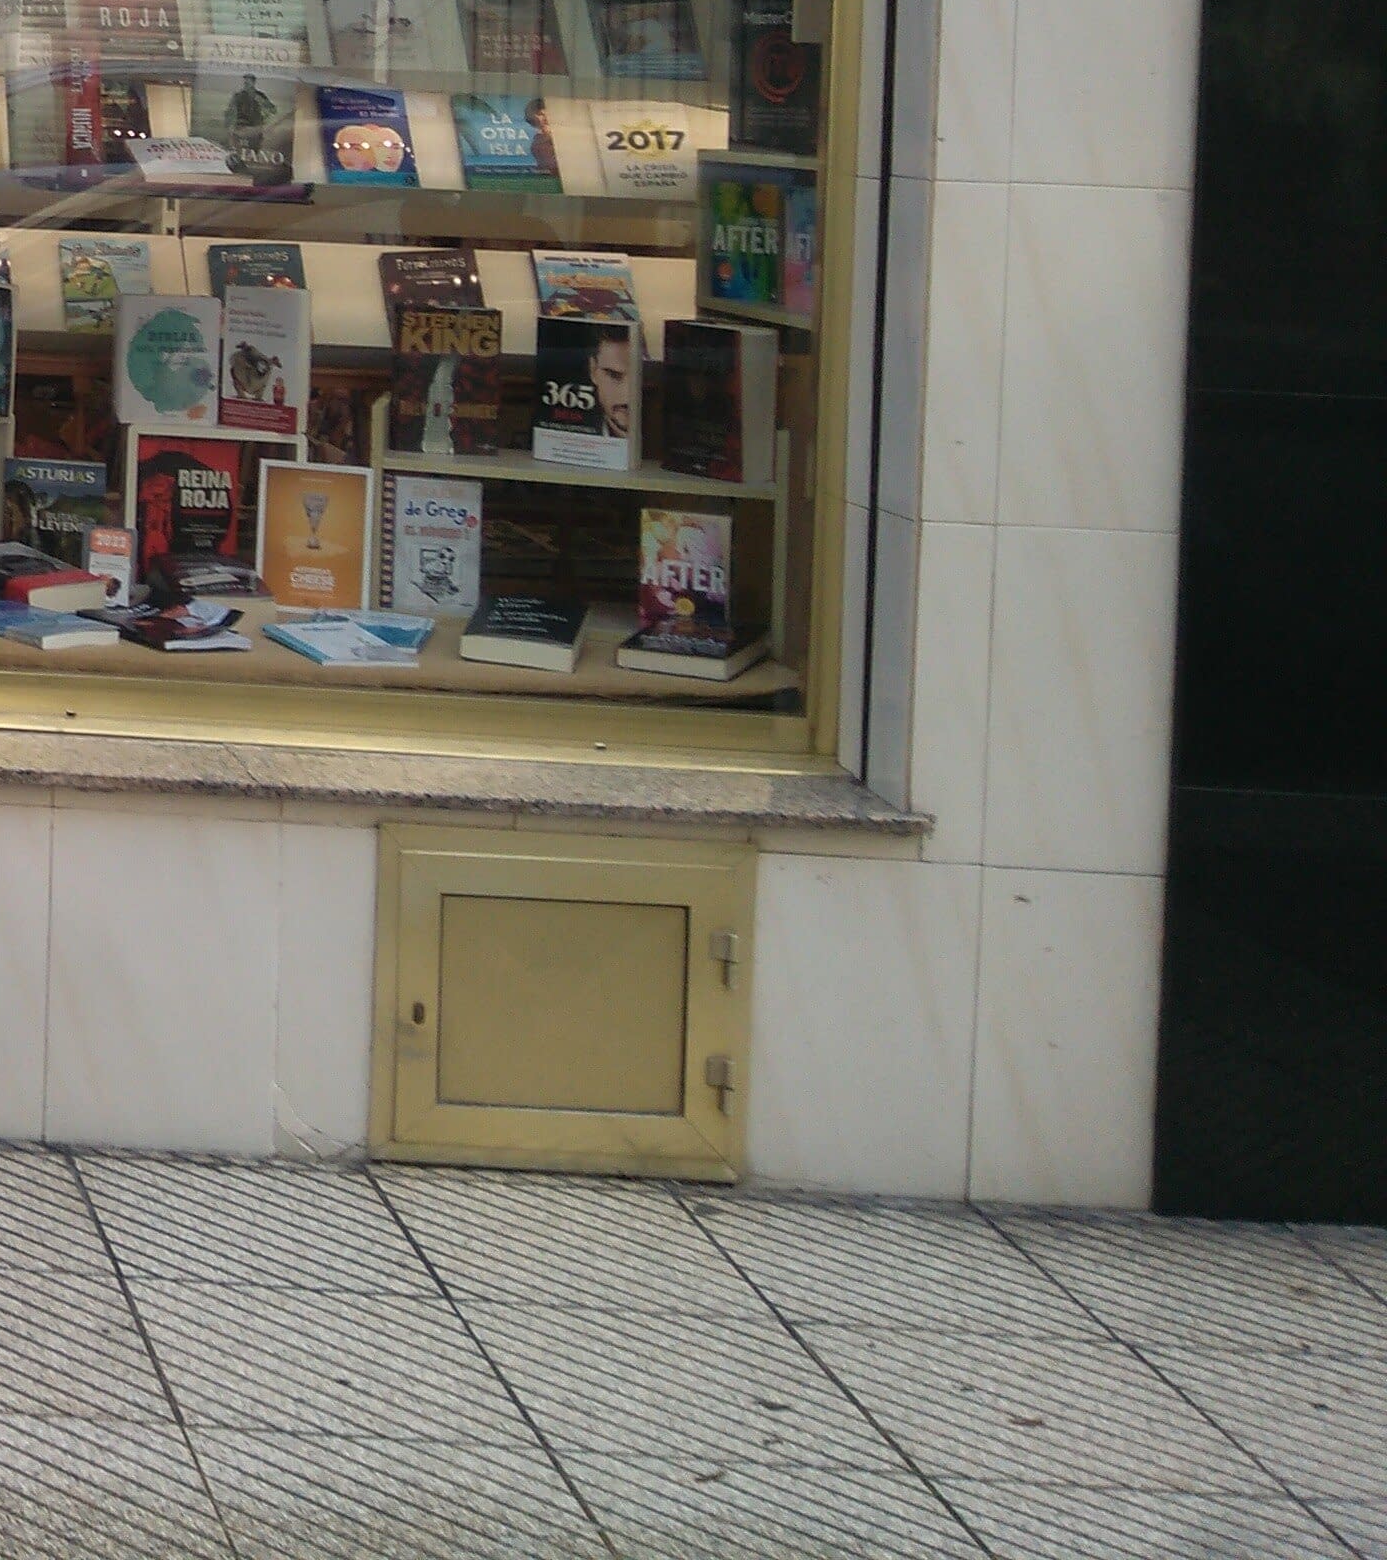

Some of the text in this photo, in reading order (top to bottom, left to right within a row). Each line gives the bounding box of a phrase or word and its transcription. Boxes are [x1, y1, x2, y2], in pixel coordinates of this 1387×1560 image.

[99, 6, 170, 28] ROJA
[490, 112, 513, 124] LA
[480, 127, 530, 141] OTRA
[605, 130, 686, 151] 2017
[489, 143, 528, 156] ISLA
[713, 224, 778, 255] AFTER
[400, 329, 502, 358] KING
[541, 380, 597, 411] 365
[16, 467, 96, 485] ASTURIAS
[178, 469, 233, 490] REINA
[180, 489, 230, 509] ROJA
[426, 501, 469, 526] Greg
